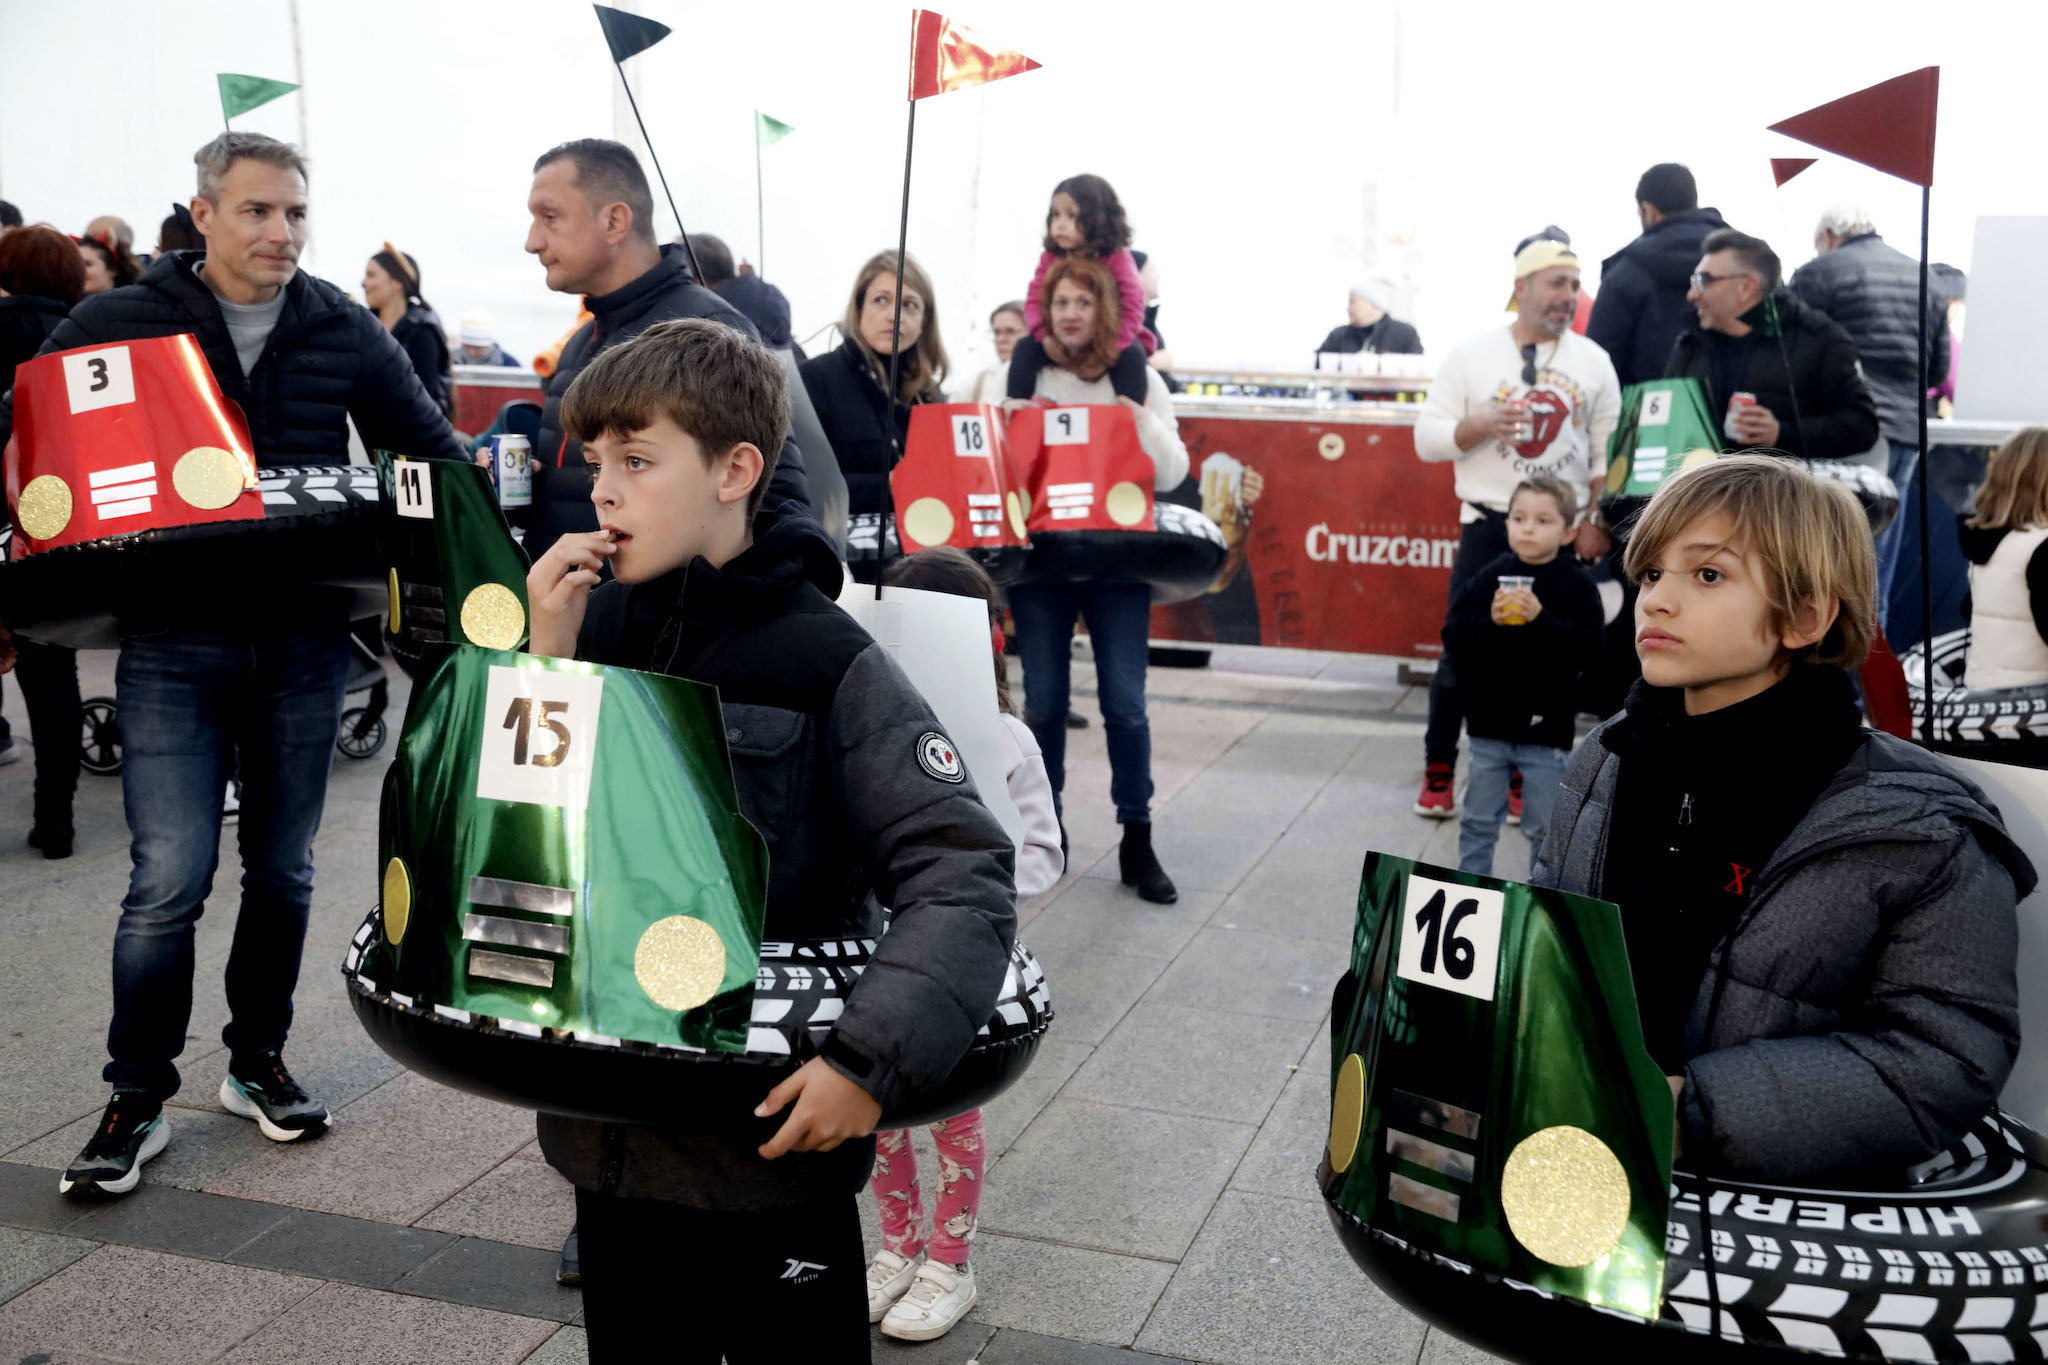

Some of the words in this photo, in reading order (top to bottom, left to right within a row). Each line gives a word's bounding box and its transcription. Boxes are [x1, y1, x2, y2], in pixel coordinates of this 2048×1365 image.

[87, 358, 109, 392] 3
[1649, 396, 1660, 415] 6
[961, 421, 983, 450] 18
[1057, 412, 1072, 436] 9
[401, 468, 422, 505] 11
[503, 697, 571, 768] 15
[1723, 862, 1751, 896] X
[1415, 888, 1479, 980] 16
[1670, 1183, 1982, 1237] HIPERF
